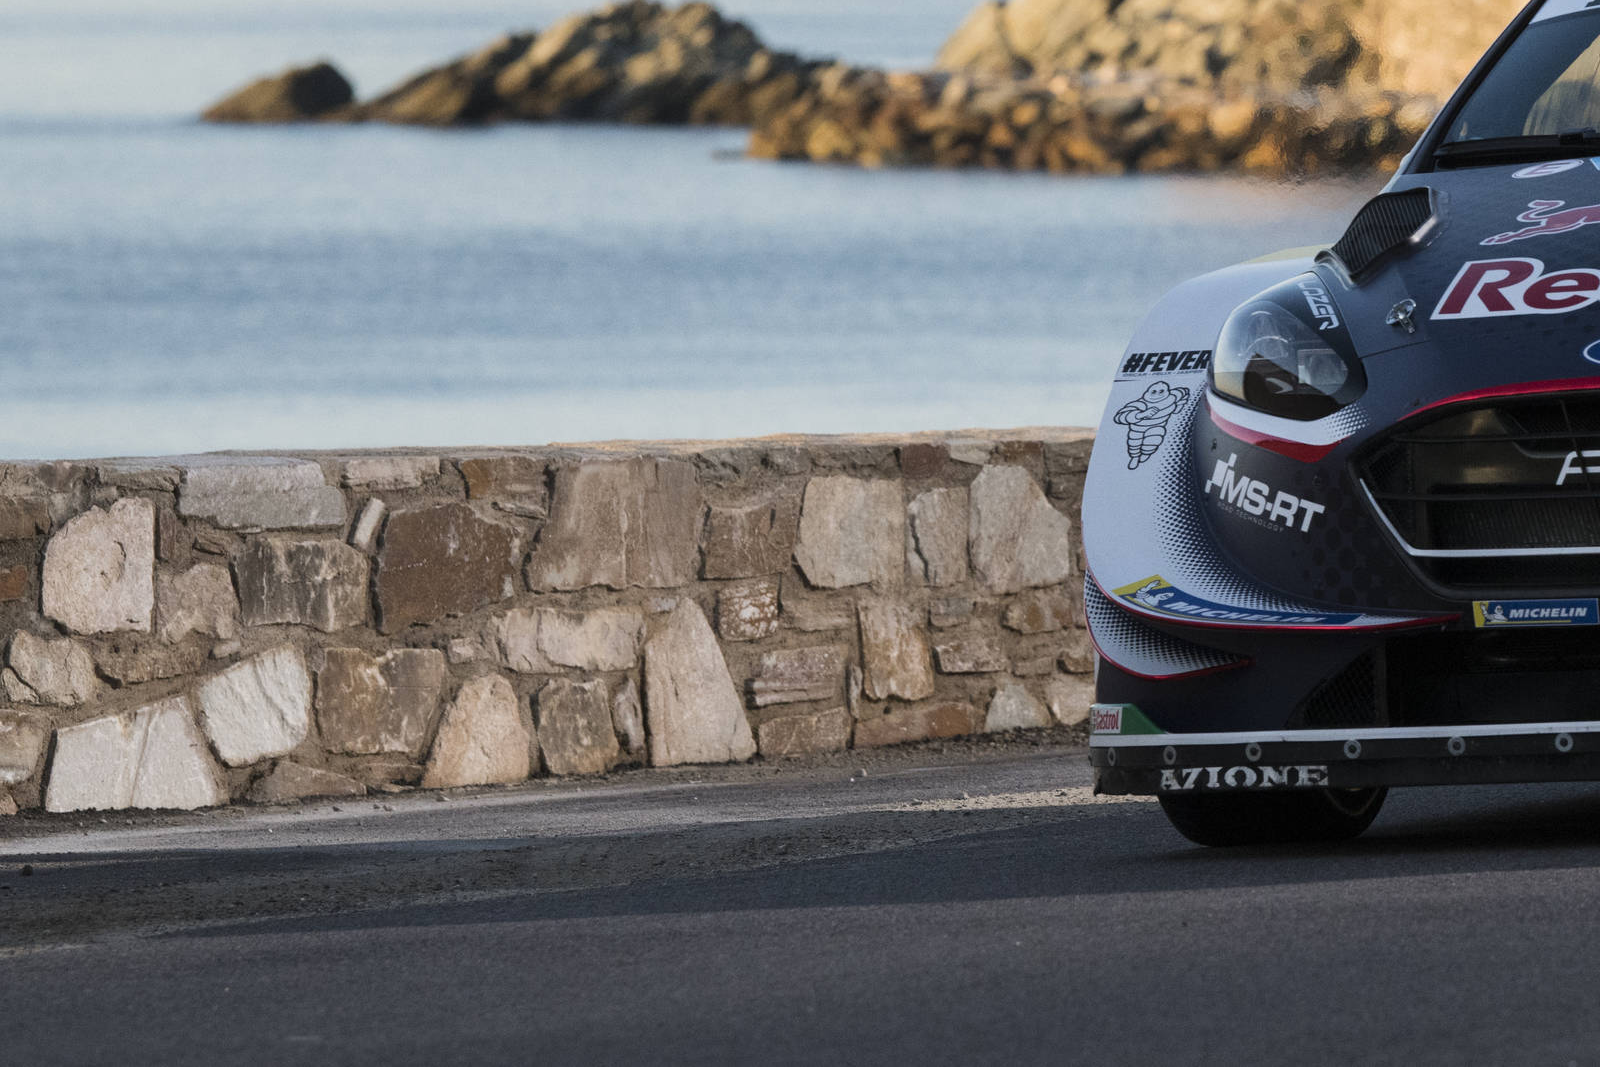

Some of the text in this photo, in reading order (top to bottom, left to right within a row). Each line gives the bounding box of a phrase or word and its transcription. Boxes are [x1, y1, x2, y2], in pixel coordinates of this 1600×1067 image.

[1122, 350, 1213, 373] #FEVER
[1163, 601, 1328, 623] MICHELIN
[1508, 606, 1588, 619] MICHELIN
